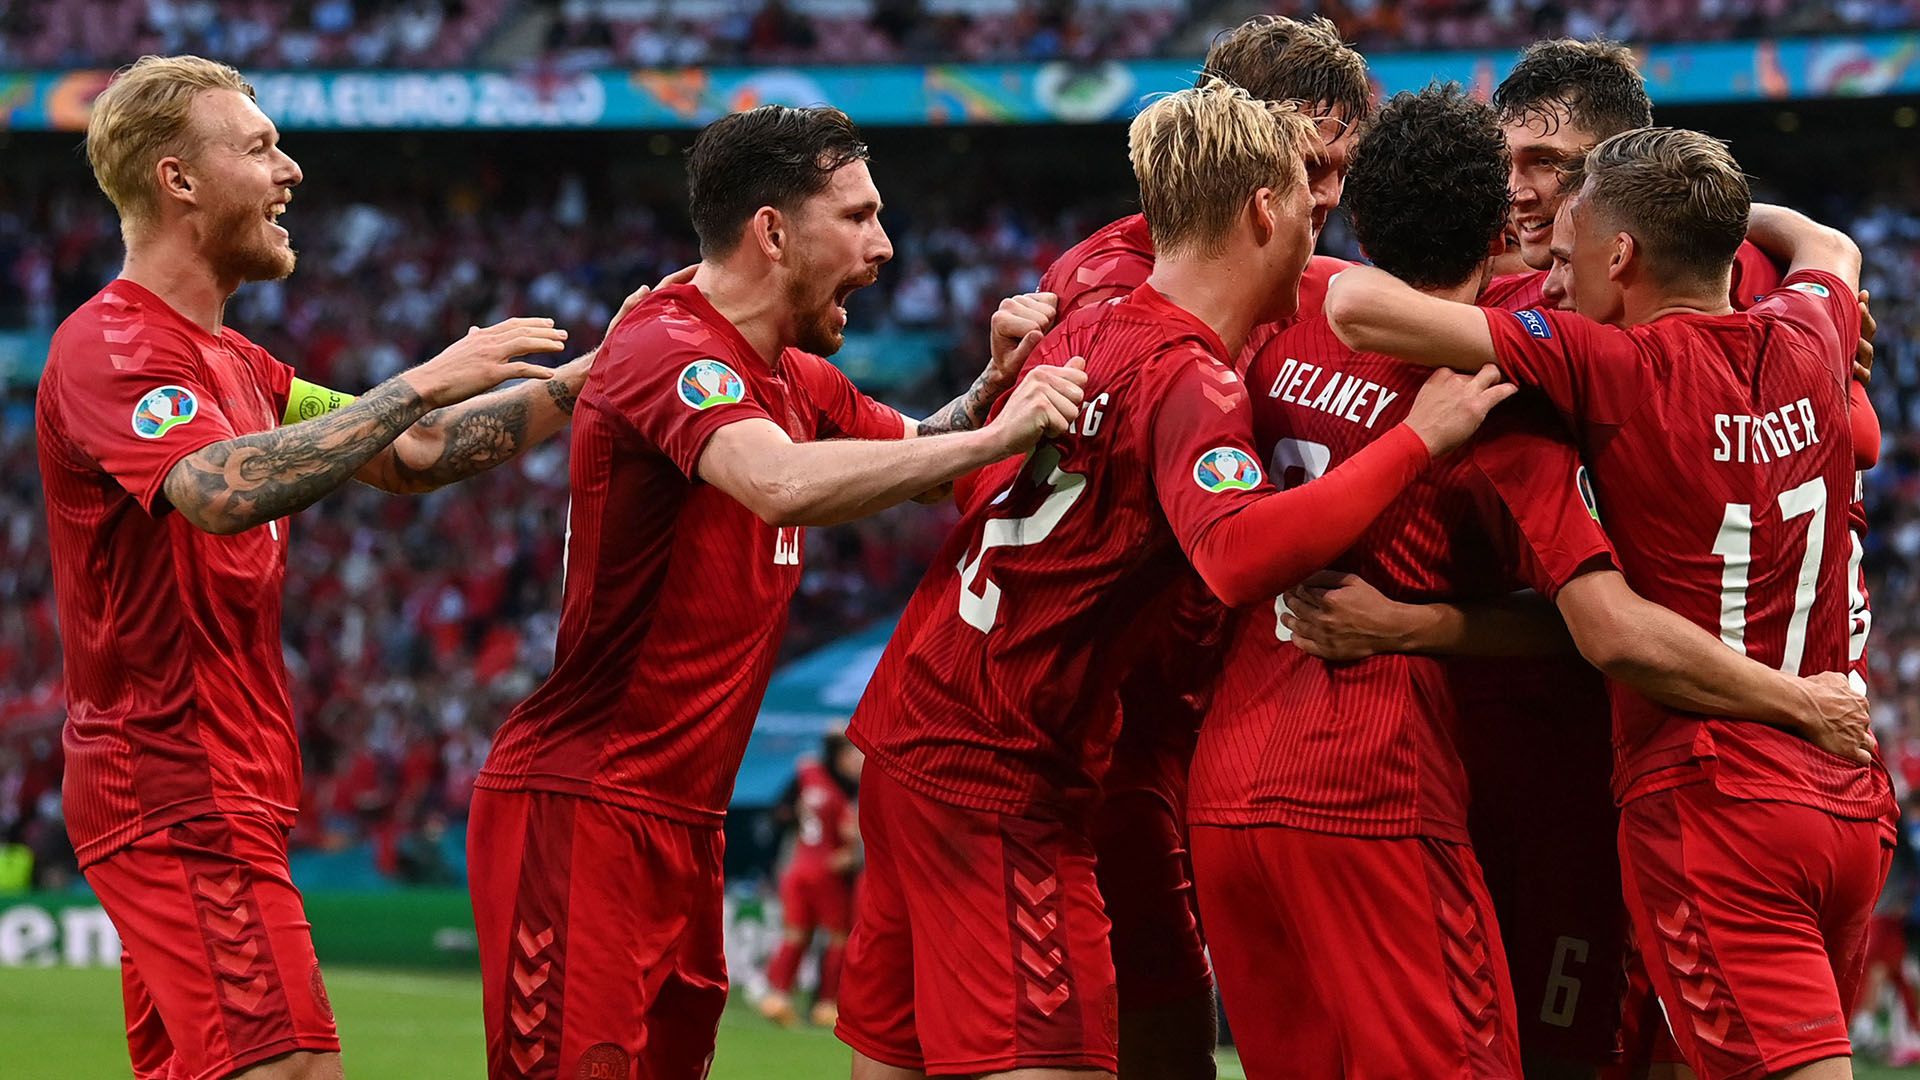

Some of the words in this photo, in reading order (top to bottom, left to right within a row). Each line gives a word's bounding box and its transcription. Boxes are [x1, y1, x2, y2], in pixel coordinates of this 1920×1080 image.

[1268, 358, 1399, 429] DELANEY
[1711, 476, 1827, 677] 17
[1540, 935, 1590, 1028] 6
